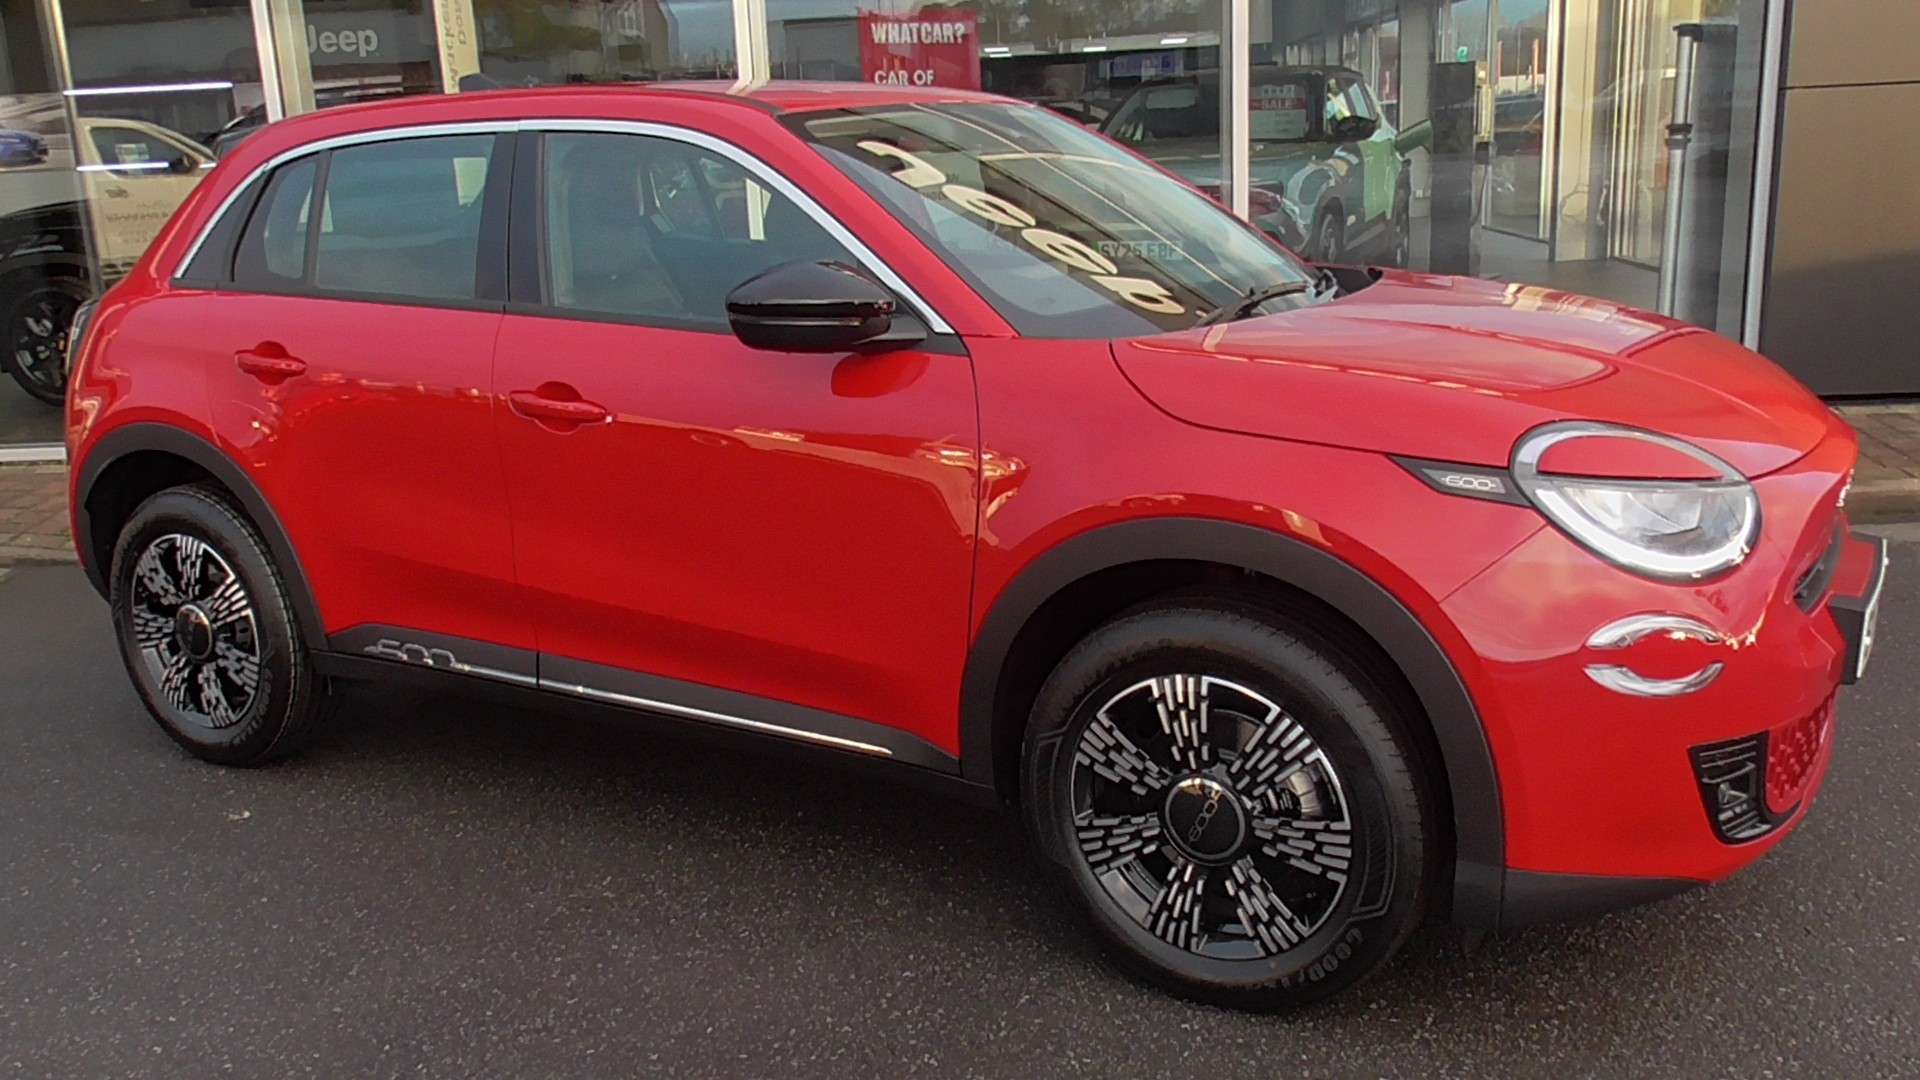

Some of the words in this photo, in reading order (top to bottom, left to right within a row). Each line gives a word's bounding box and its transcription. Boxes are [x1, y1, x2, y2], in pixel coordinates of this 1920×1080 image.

[308, 25, 378, 57] Jeep
[874, 70, 908, 86] CAR
[913, 69, 935, 86] OF
[1443, 475, 1494, 491] 600
